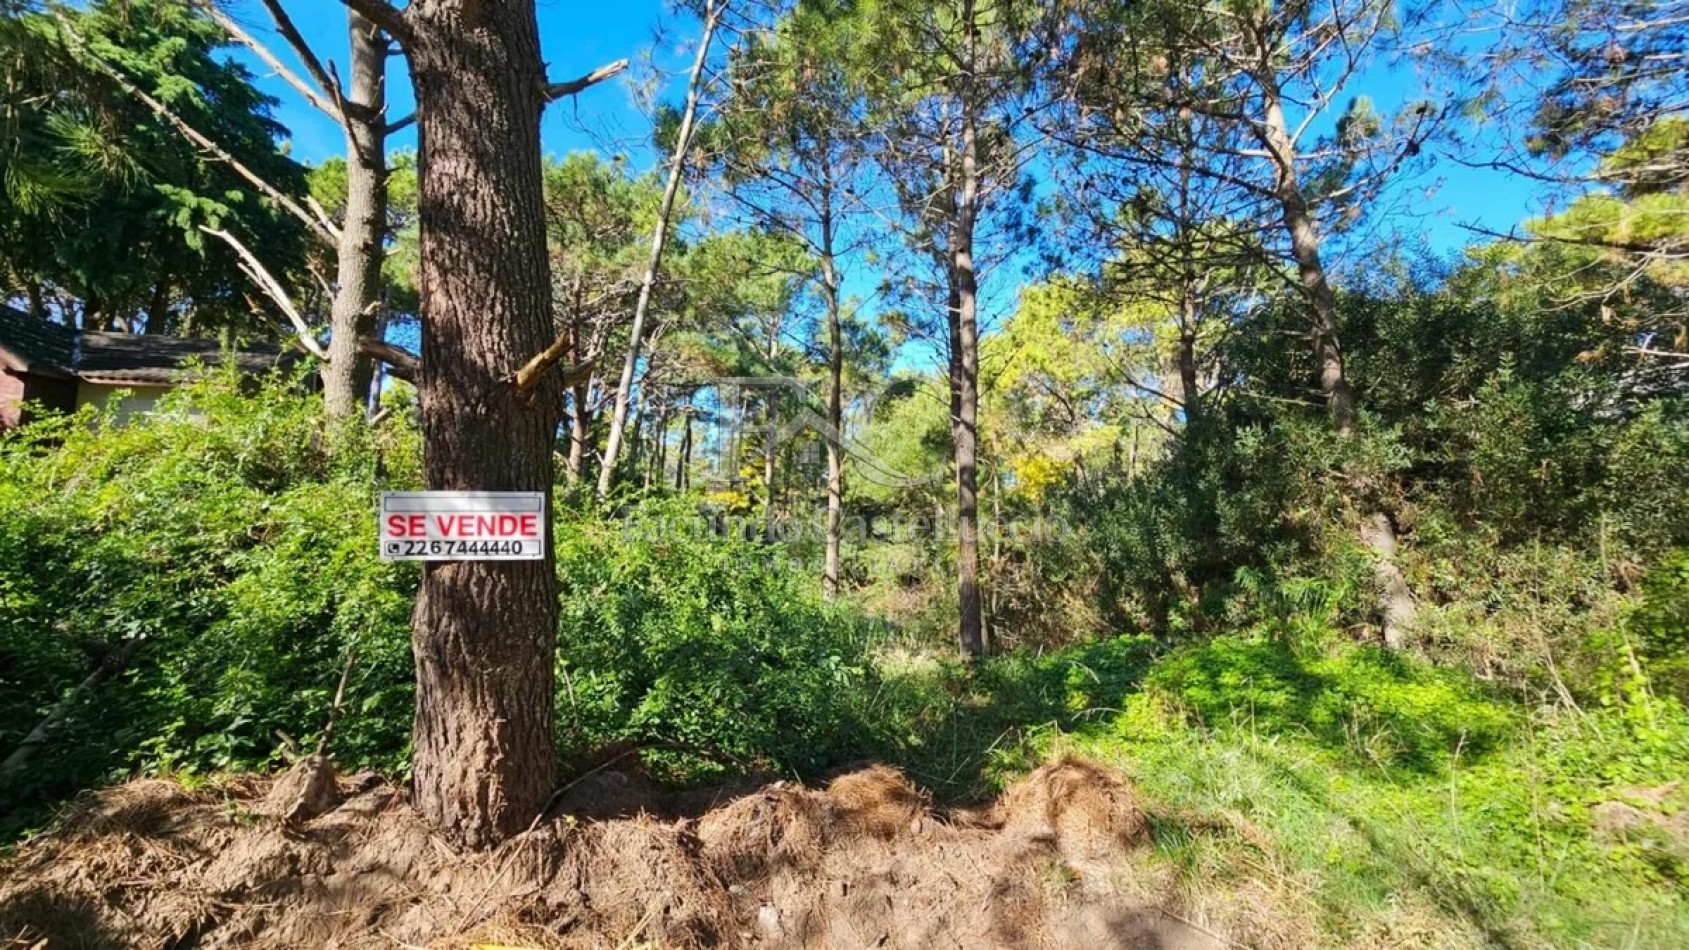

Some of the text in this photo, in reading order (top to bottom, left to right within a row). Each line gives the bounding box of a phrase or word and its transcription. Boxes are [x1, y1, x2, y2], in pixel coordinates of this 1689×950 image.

[387, 515, 538, 537] SE VENDE
[404, 540, 523, 555] 2267444440
